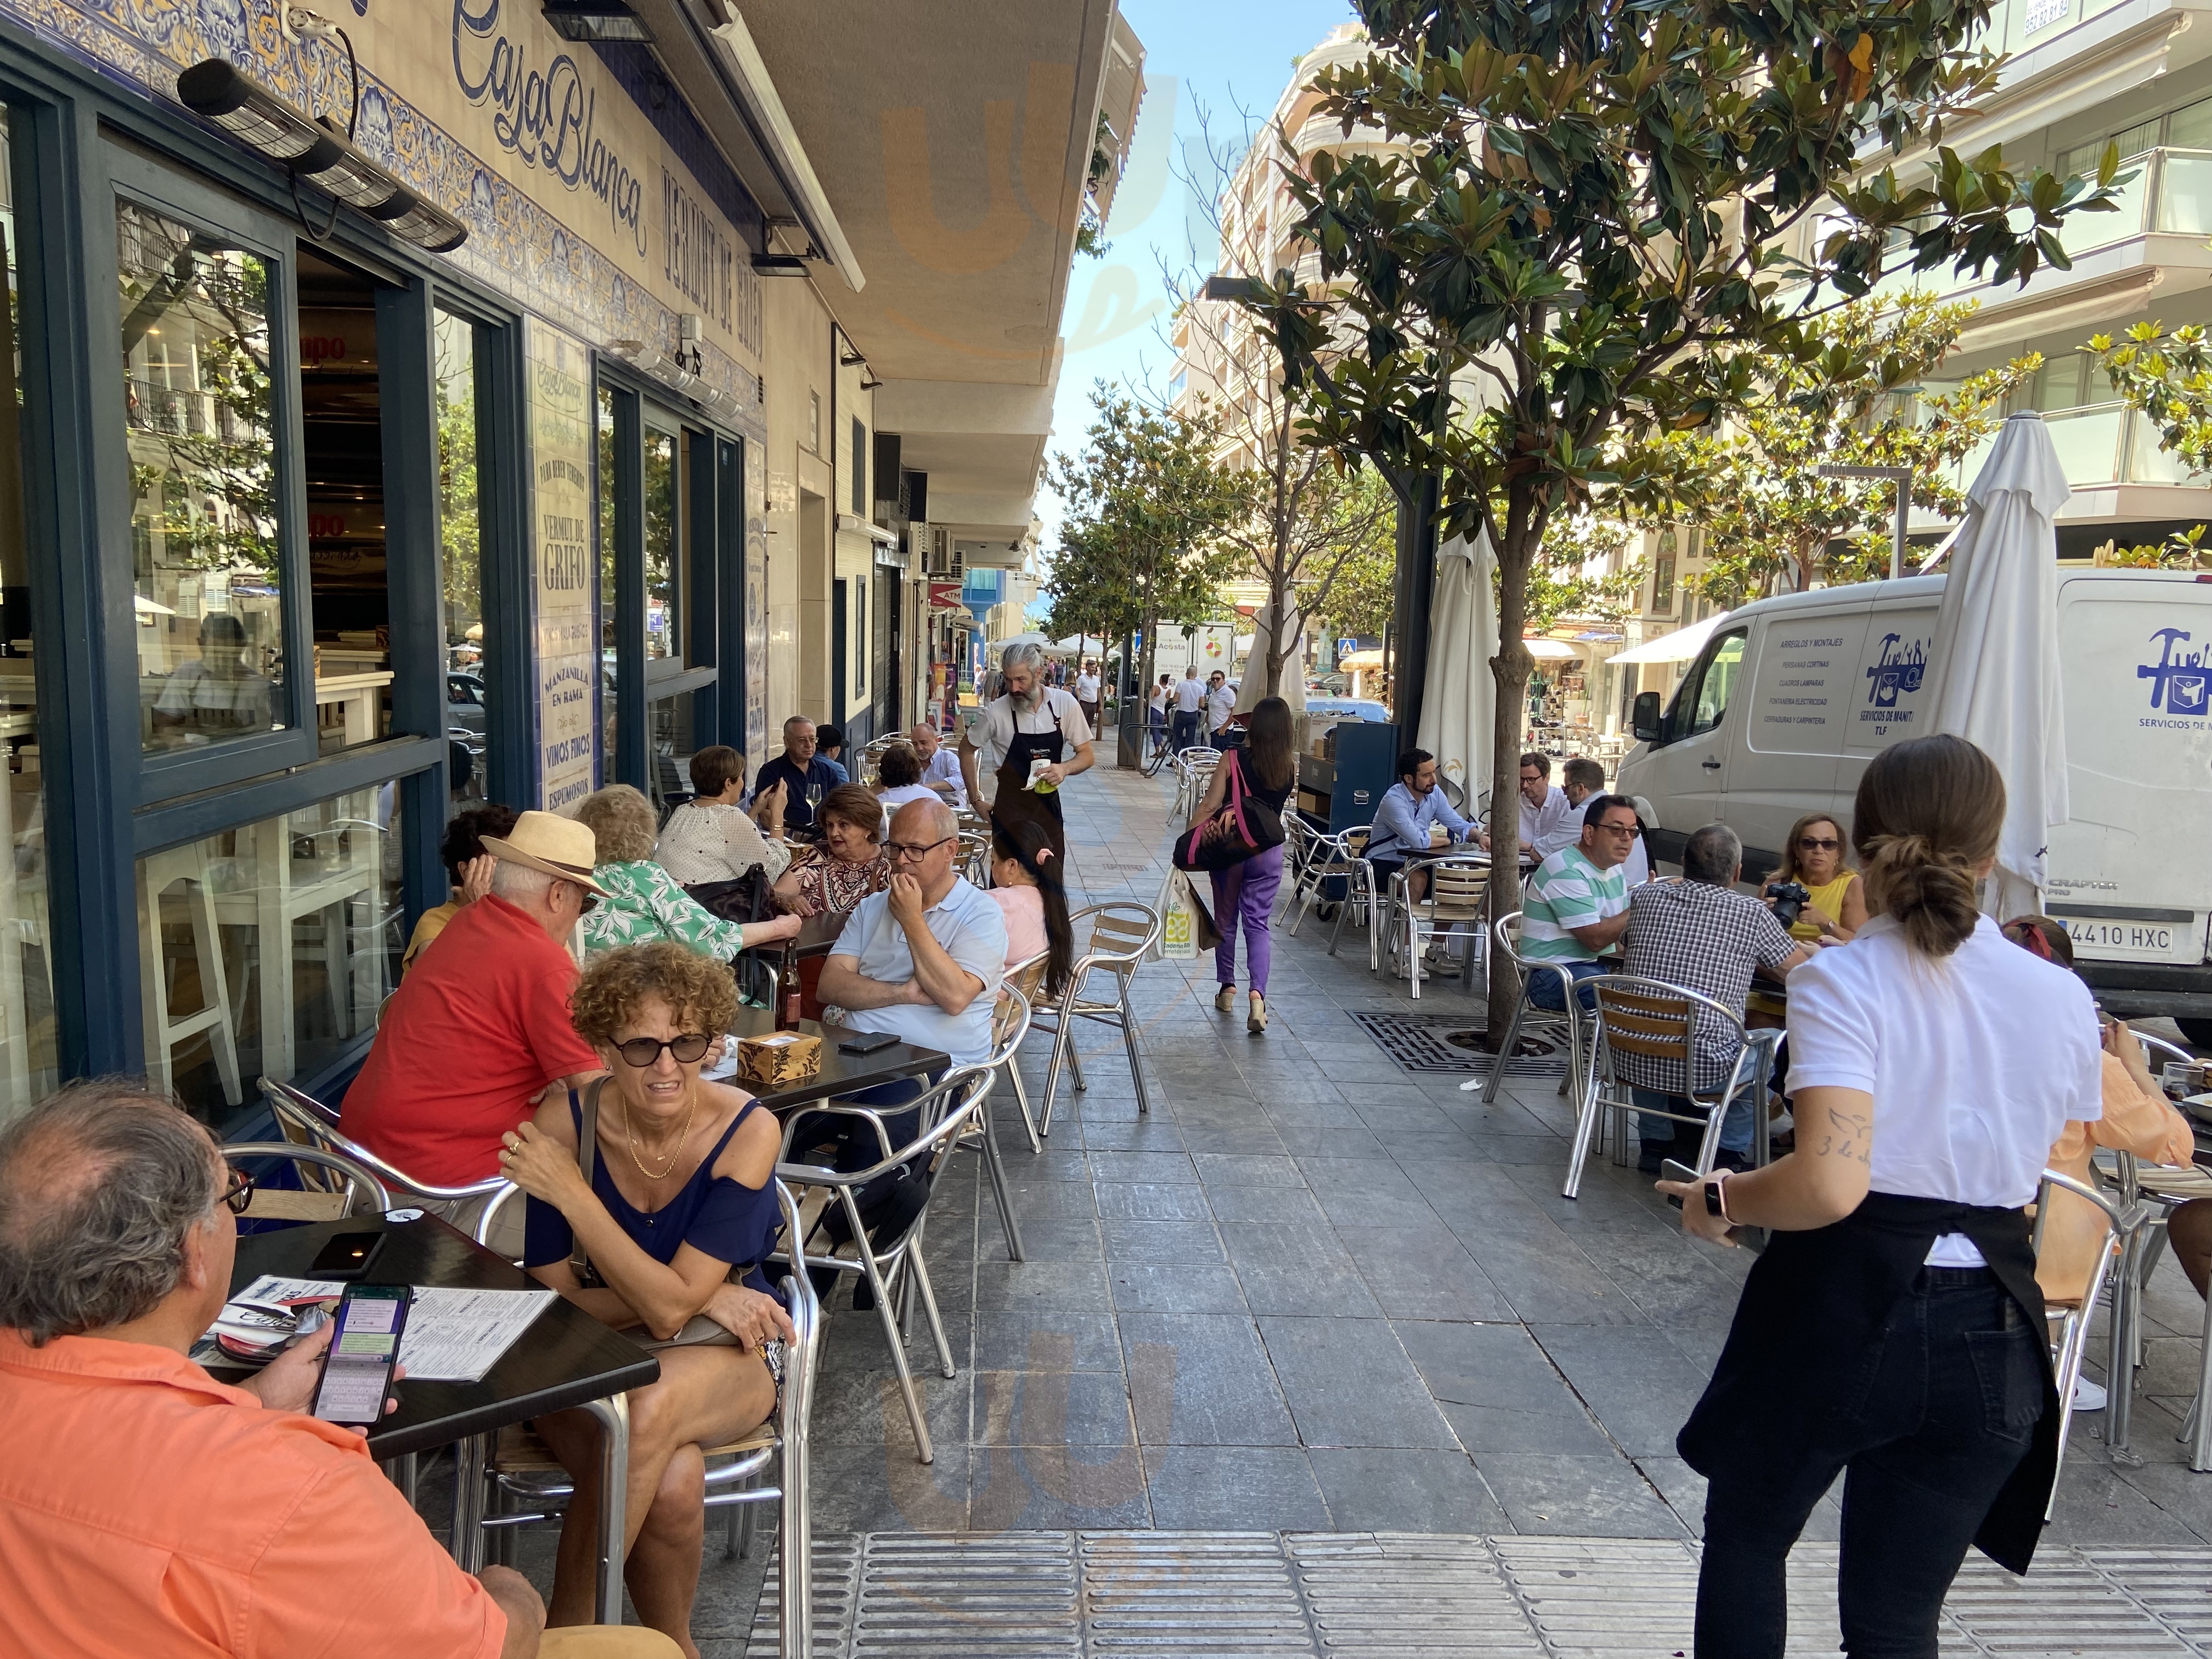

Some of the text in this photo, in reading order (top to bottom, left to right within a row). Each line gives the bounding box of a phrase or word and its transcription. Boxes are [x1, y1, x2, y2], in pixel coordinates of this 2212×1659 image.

[2025, 14, 2038, 34] 952
[2039, 9, 2047, 26] 82
[2049, 3, 2057, 21] 81
[661, 165, 763, 363] VERMUT DE GRIFO
[539, 459, 585, 493] PARA BEBER TENEMOS
[543, 514, 585, 543] VERMUT DE
[544, 543, 586, 590] GRIFO
[1780, 639, 1809, 648] ARREGLOS
[1814, 638, 1843, 647] MONTAJES
[545, 667, 589, 696] MANZANILLA
[552, 687, 583, 707] EN RAMA
[1796, 716, 1825, 725] CARPINTERIA
[1859, 711, 1914, 721] SERVICIOS DE MANIT
[2138, 718, 2190, 729] SERVICIOS
[2193, 721, 2205, 731] DE
[1875, 726, 1888, 736] TLF
[546, 733, 590, 769] VINOS FINOS
[549, 777, 589, 811] ESPUMOSOS
[2048, 879, 2119, 890] CRAFTER
[2070, 924, 2169, 949] 4410 HXC
